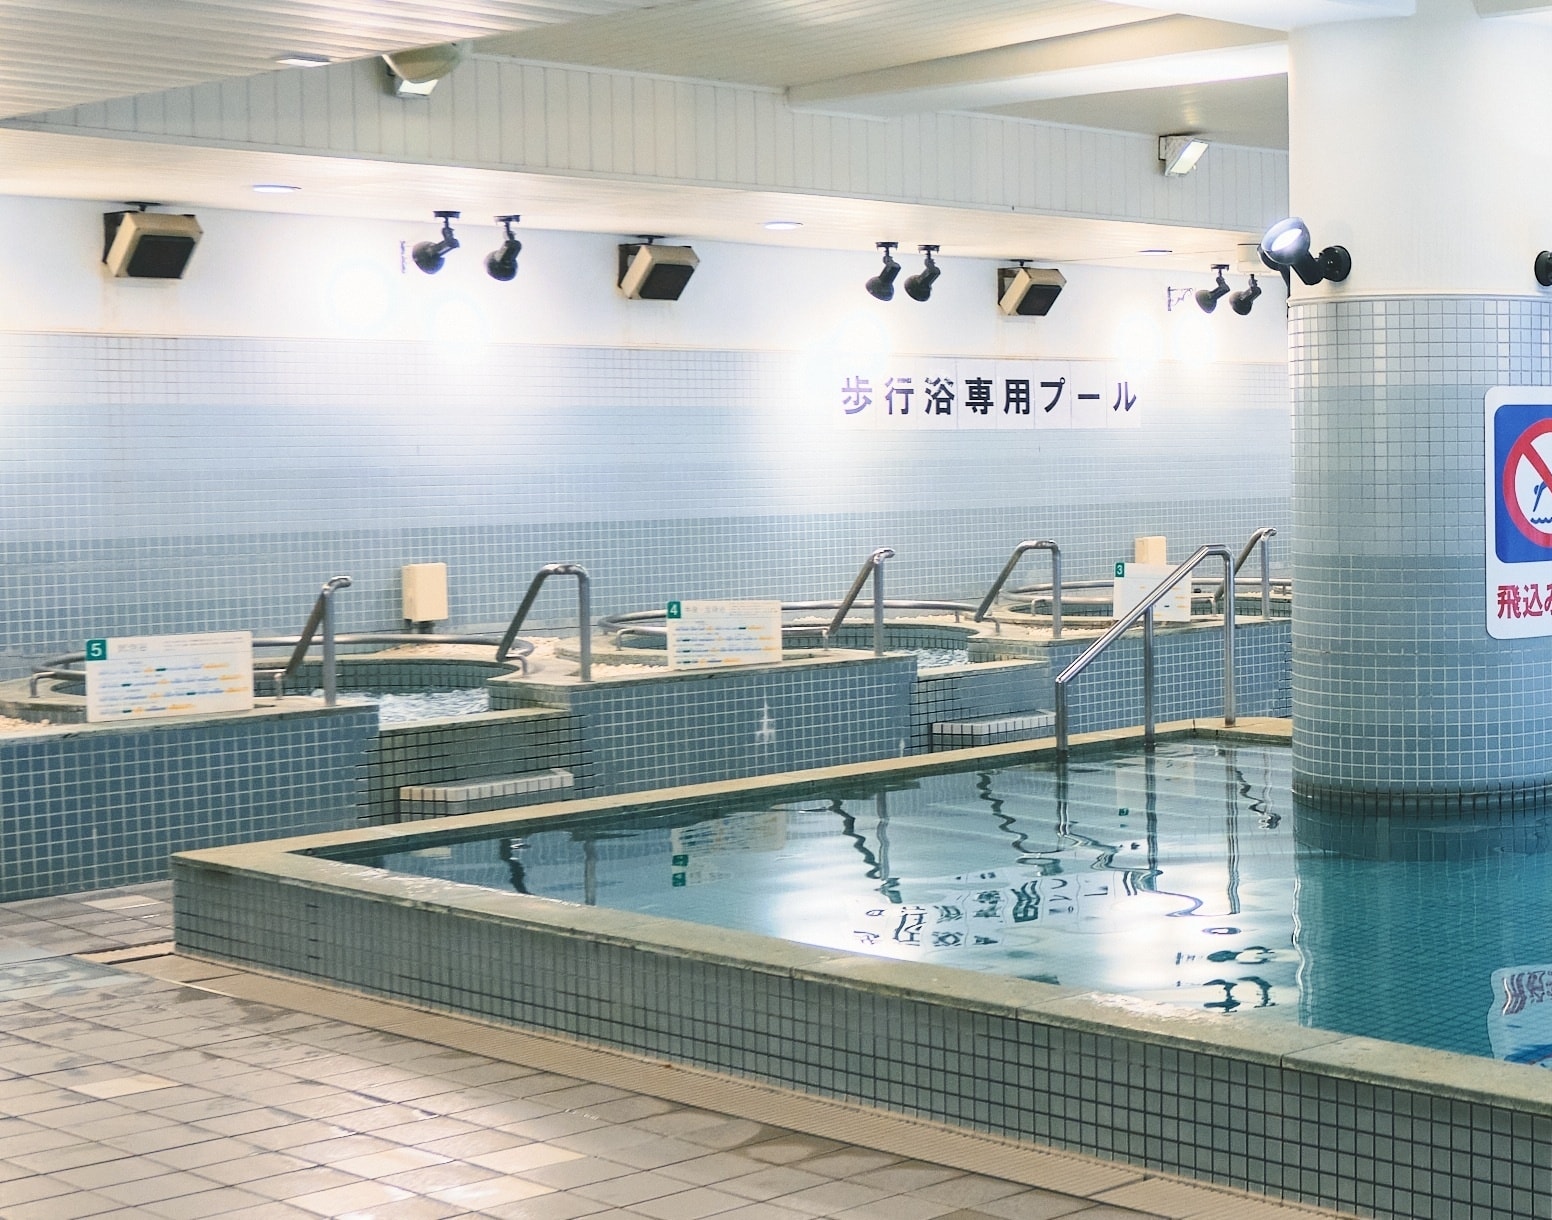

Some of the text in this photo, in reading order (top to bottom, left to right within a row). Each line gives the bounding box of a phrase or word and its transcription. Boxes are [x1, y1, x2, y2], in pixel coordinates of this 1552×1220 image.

[840, 375, 1138, 416] 歩行浴専用プール
[1116, 565, 1123, 575] 3
[669, 604, 678, 616] 4
[91, 643, 102, 657] 5
